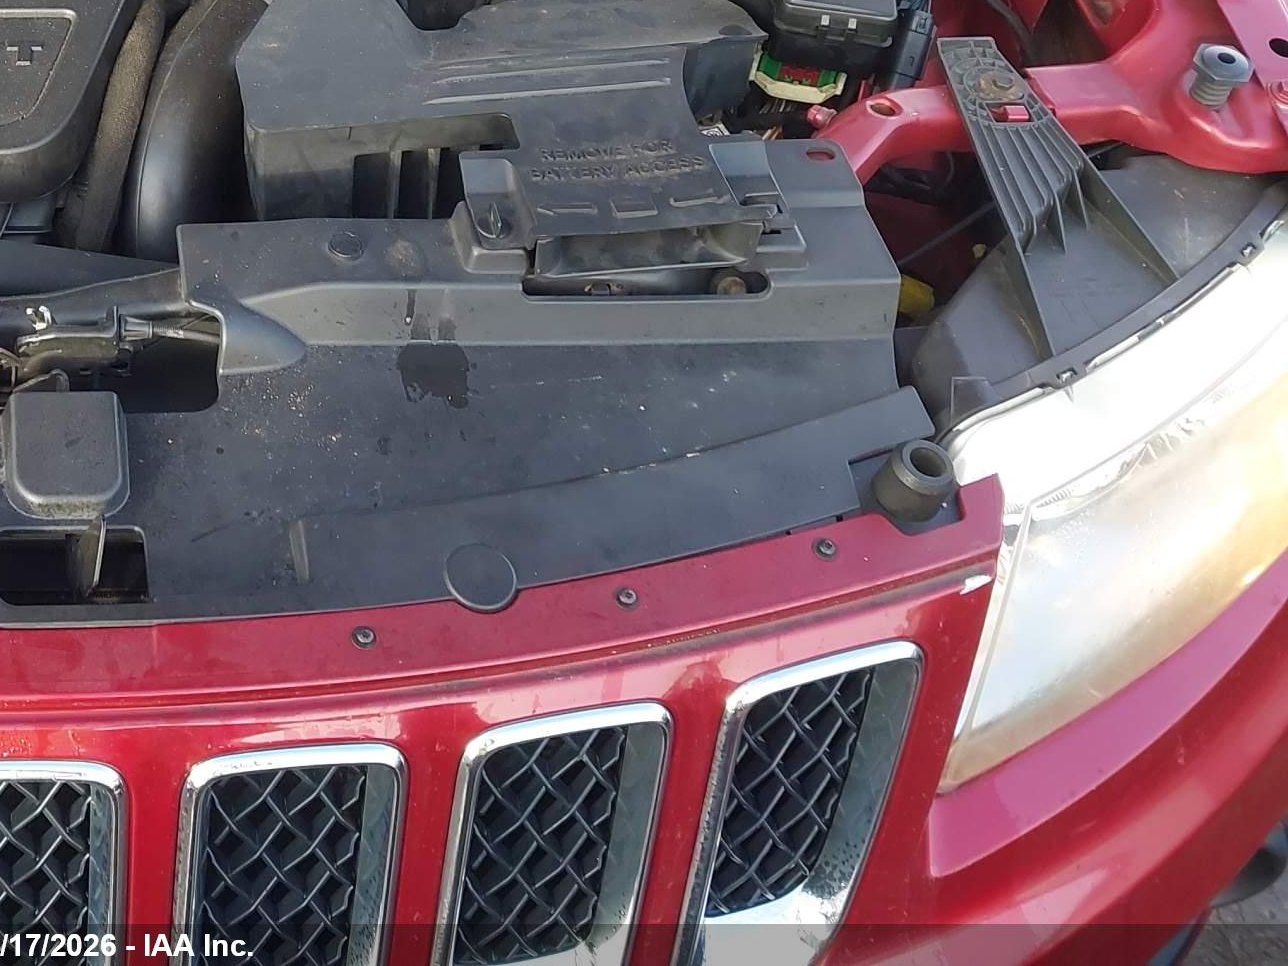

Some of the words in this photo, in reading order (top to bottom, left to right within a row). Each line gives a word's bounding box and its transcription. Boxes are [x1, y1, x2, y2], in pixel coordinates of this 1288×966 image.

[540, 144, 626, 162] REMOVE
[630, 138, 675, 157] FOR
[529, 163, 617, 182] BATTERY
[624, 155, 705, 177] ACCESS
